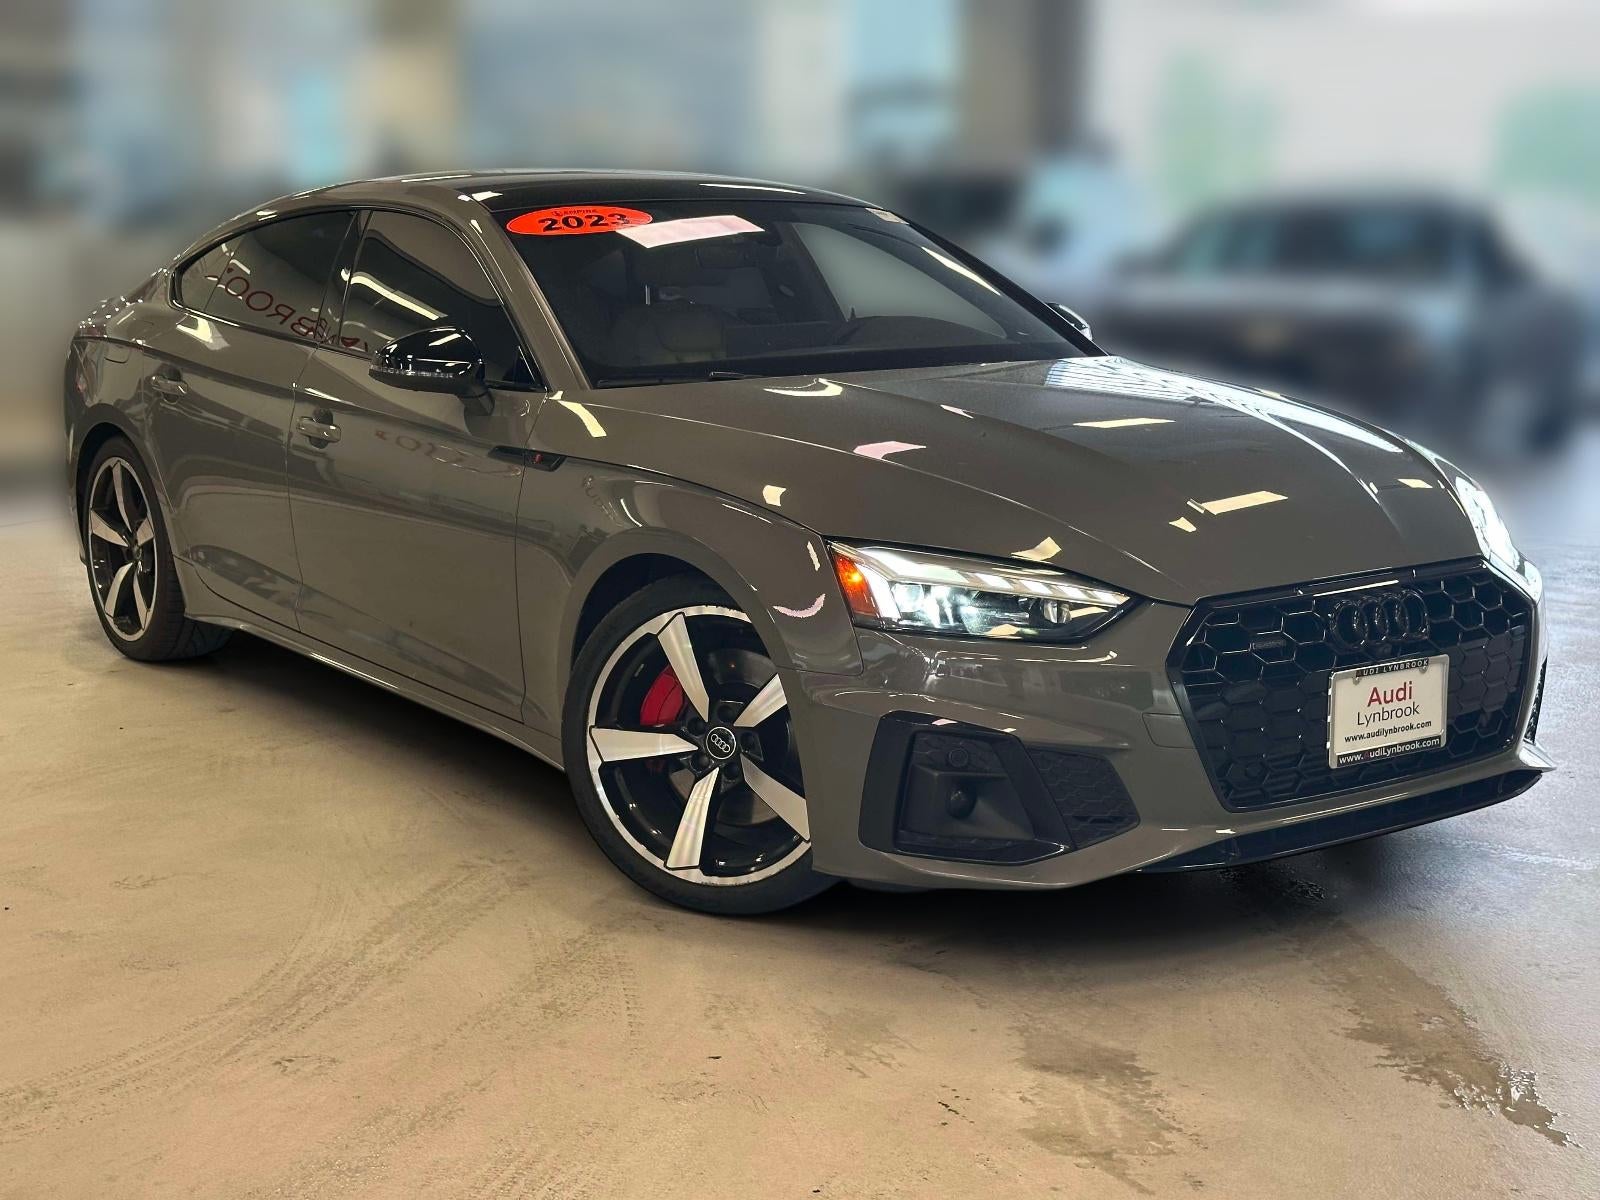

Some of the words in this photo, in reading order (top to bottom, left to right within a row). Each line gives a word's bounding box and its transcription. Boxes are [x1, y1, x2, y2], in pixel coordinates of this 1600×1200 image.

[538, 212, 631, 232] 2023
[1382, 659, 1429, 673] LYNBROOK
[1367, 680, 1414, 707] Audi
[1357, 702, 1421, 727] Lynbrook
[1344, 720, 1432, 743] www.audilynbrook.com
